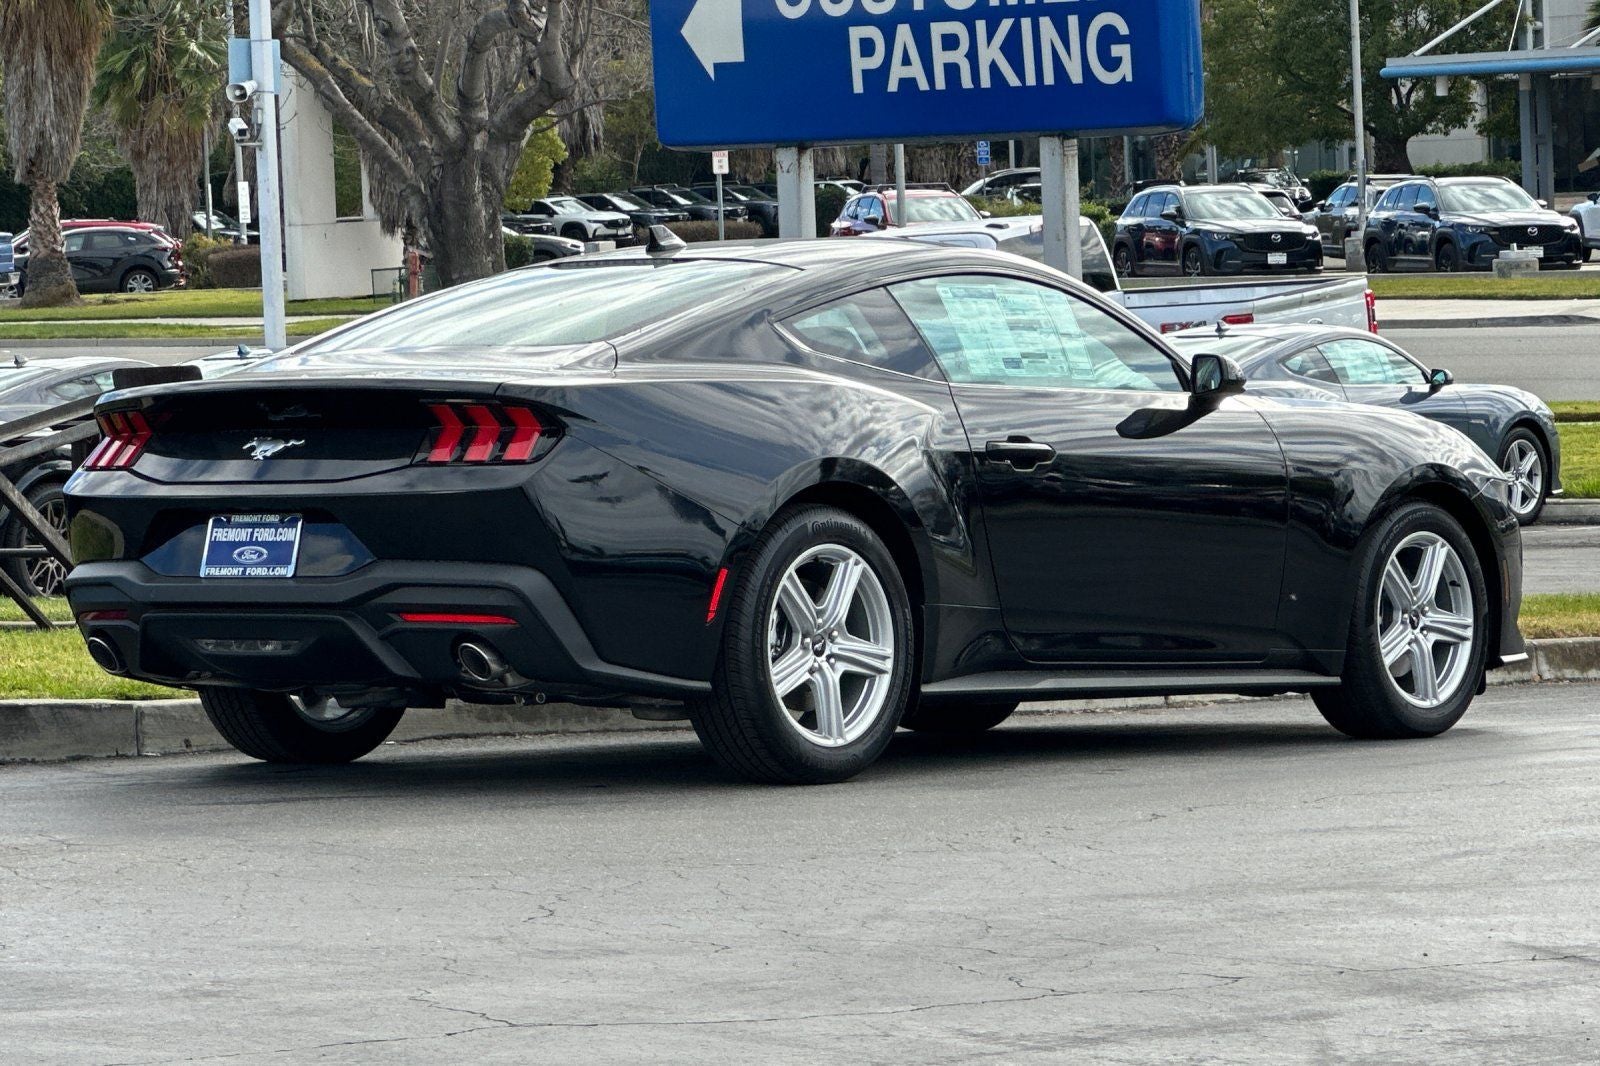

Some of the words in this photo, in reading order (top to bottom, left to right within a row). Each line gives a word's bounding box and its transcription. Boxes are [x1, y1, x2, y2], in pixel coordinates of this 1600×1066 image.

[848, 12, 1133, 95] PARKING
[262, 514, 280, 522] FORD
[811, 517, 863, 536] Continental
[211, 528, 252, 541] FREMONT
[253, 527, 296, 541] FORD.COM
[241, 549, 259, 559] Ford
[206, 567, 244, 575] FREMONT
[246, 567, 288, 575] FORD.COM
